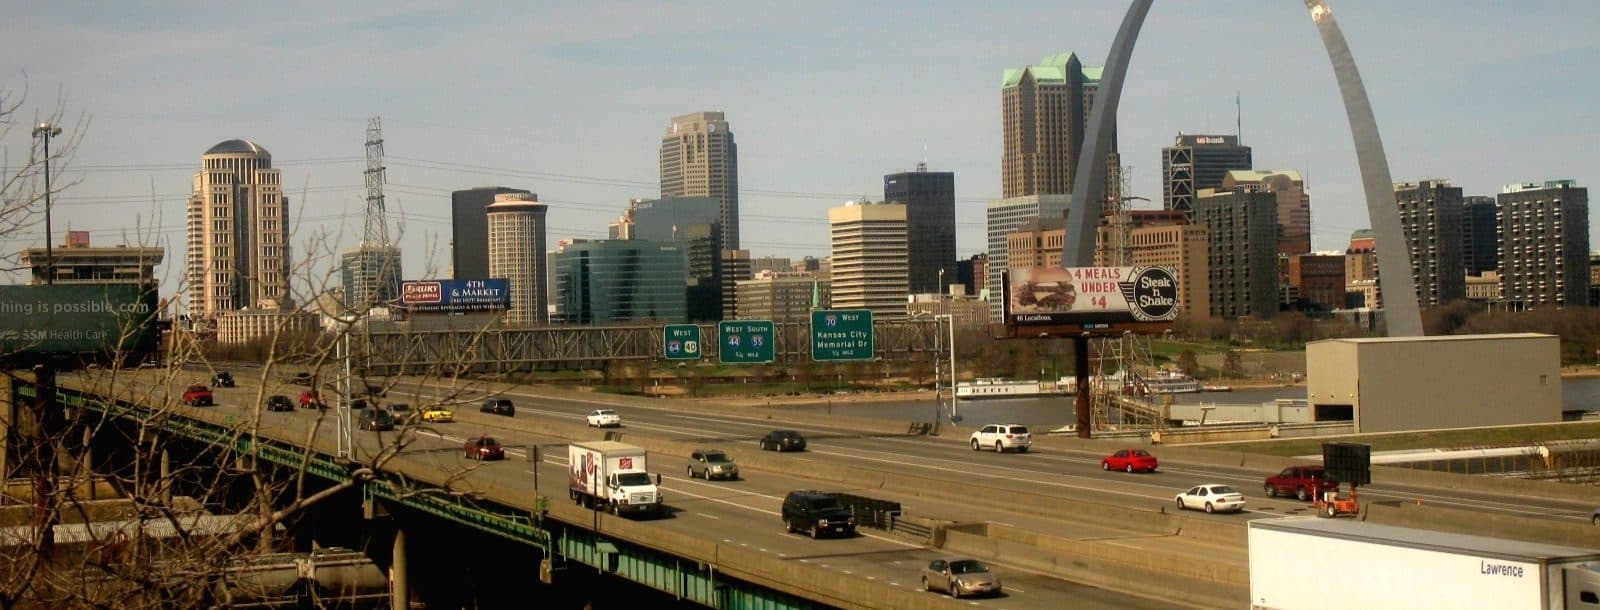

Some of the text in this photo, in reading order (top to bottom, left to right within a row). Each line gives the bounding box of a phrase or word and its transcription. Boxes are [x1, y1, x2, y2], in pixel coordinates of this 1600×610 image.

[1075, 269, 1081, 279] 4
[1085, 268, 1121, 279] MEALS
[466, 280, 484, 288] 4TH
[1081, 282, 1116, 293] UNDER
[1141, 276, 1171, 288] Steak
[451, 289, 500, 297] & MARKET
[1091, 296, 1107, 308] $4
[1140, 295, 1174, 307] Shake
[38, 301, 49, 313] is
[23, 329, 108, 341] SSM Health Care
[817, 330, 867, 339] Kansas City
[686, 342, 696, 351] 40
[728, 337, 763, 347] 44 55
[817, 340, 855, 348] Memorial
[1480, 560, 1524, 577] Lawrence
